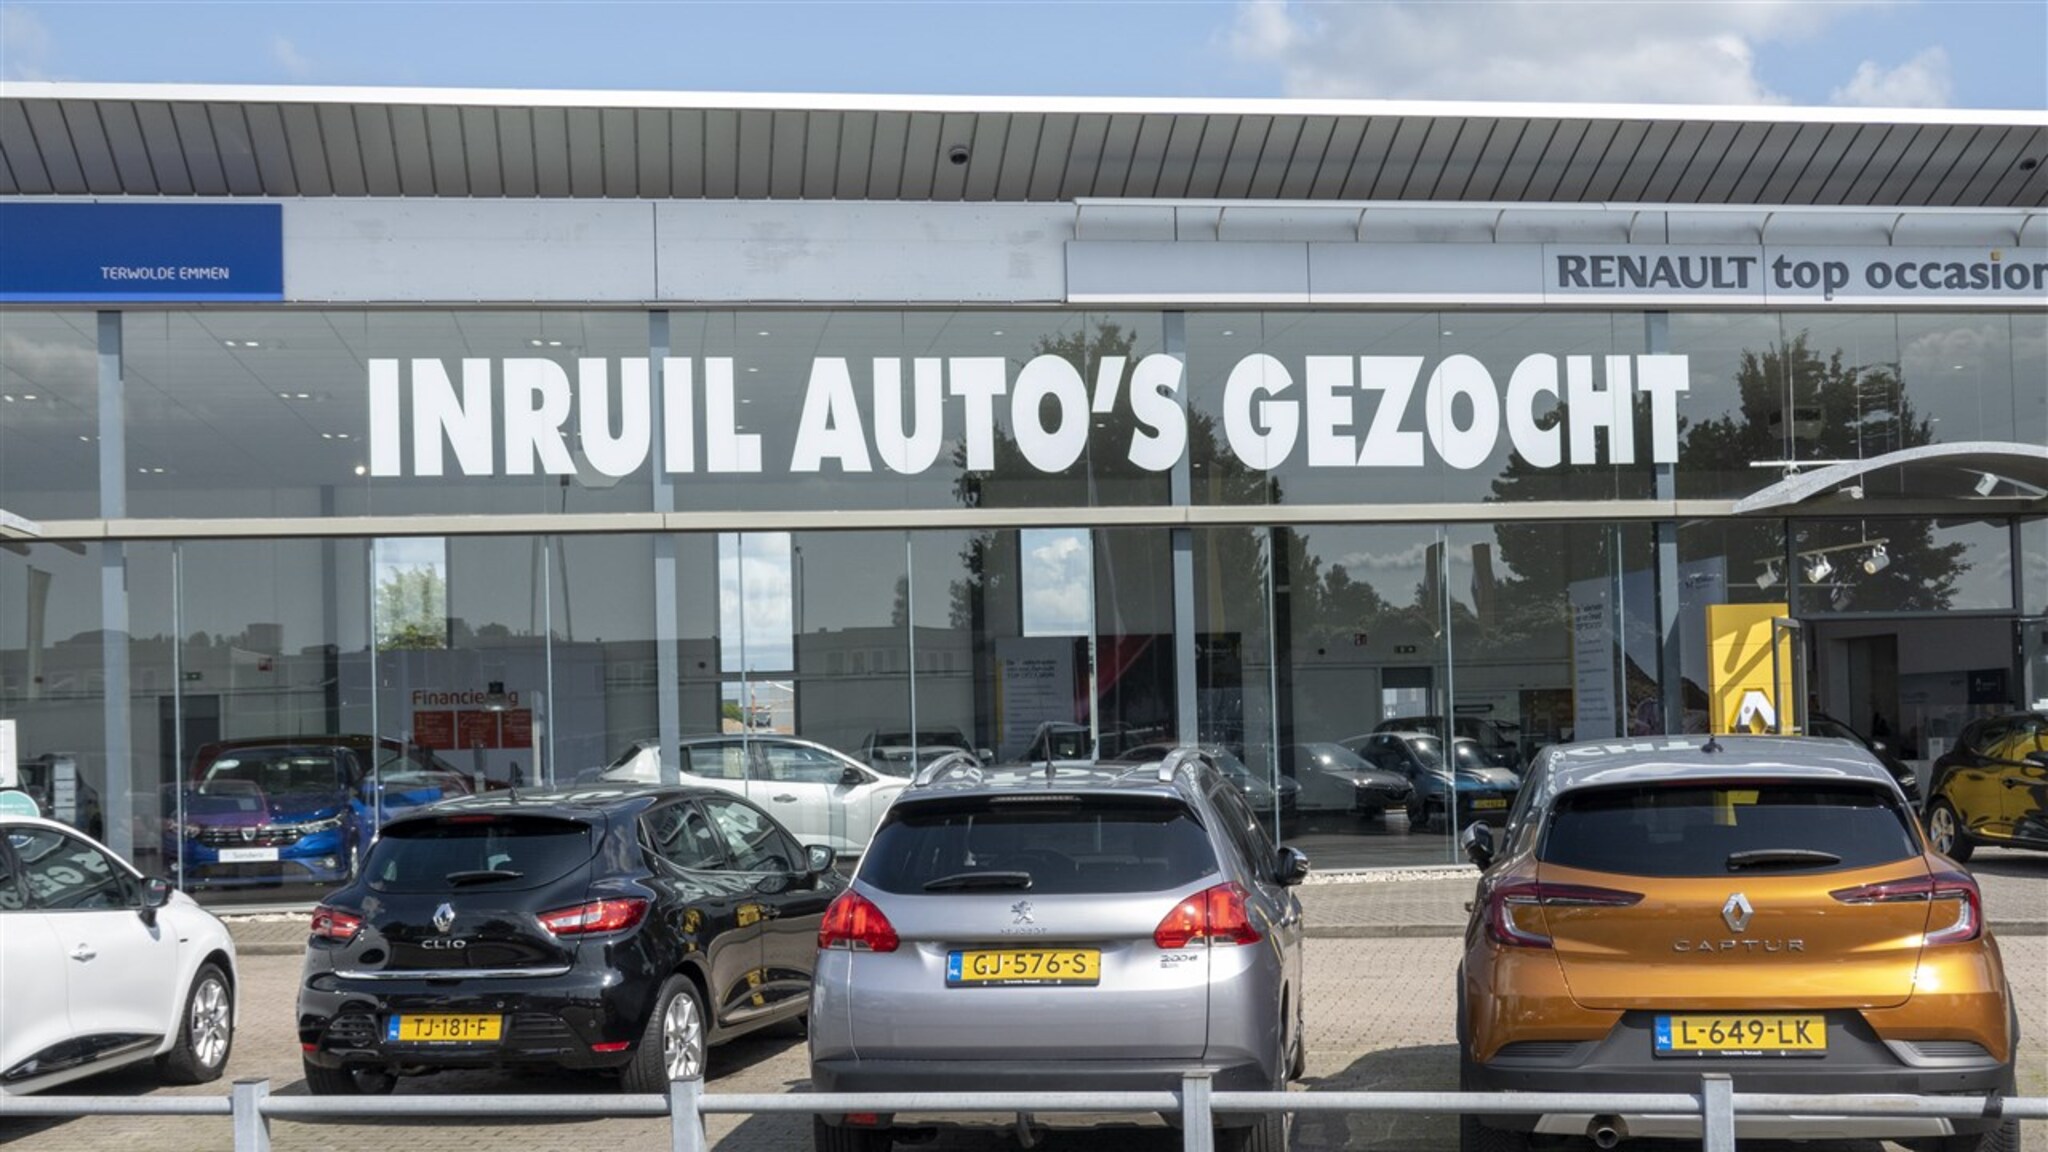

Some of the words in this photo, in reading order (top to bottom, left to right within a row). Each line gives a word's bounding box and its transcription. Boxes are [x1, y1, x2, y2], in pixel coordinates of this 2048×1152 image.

[101, 266, 176, 280] TERWOLDE
[179, 266, 230, 280] EMMEN
[1557, 255, 1757, 288] RENAULT
[1772, 254, 1849, 301] top
[367, 356, 762, 477] INRUIL
[790, 353, 1188, 474] AUTO'S
[1223, 353, 1690, 470] GEZOCHT
[411, 688, 519, 706] Financieg
[421, 940, 467, 949] CLIO
[1673, 939, 1804, 952] CAPTUR
[973, 953, 1087, 976] GJ-576-S
[413, 1018, 488, 1037] TJ-181-F
[1681, 1019, 1814, 1045] L-649-LK
[1658, 1036, 1671, 1044] NL
